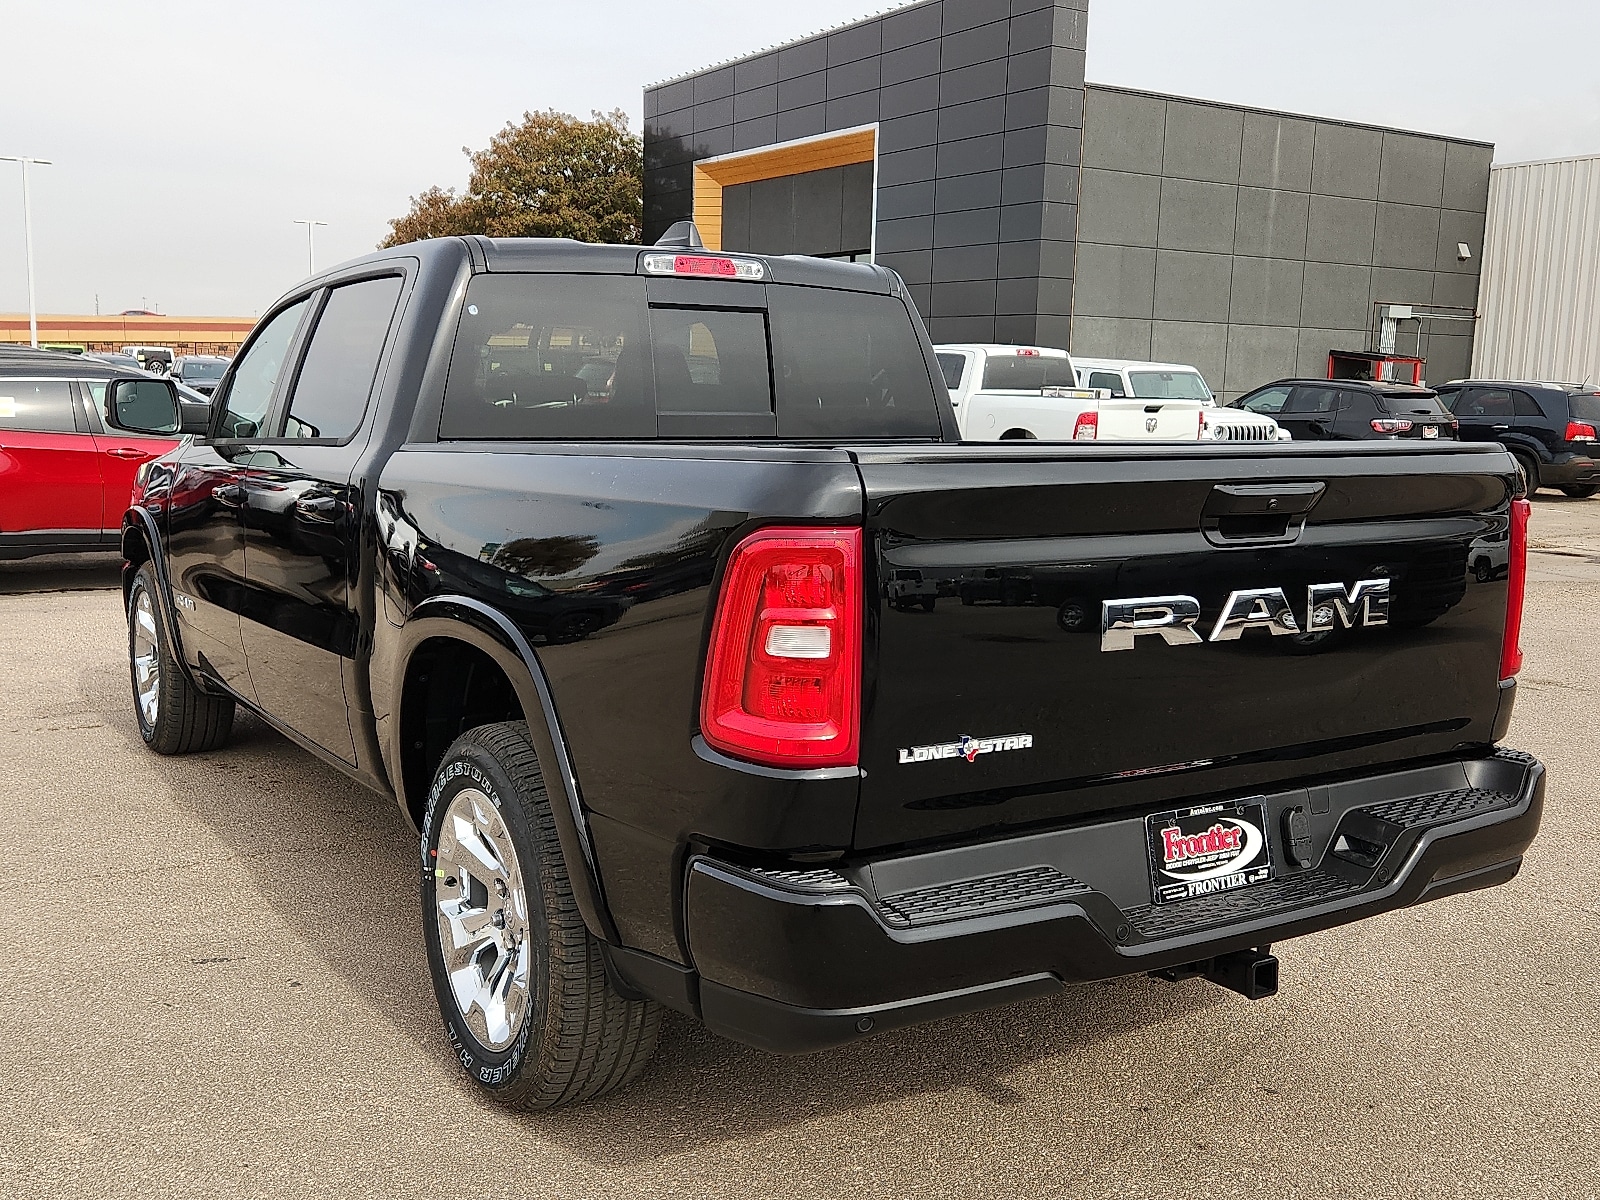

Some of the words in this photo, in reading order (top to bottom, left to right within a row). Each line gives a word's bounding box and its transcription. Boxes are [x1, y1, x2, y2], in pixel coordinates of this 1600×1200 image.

[1101, 579, 1390, 652] RAM
[898, 742, 962, 764] LONE
[978, 734, 1033, 754] STAR
[1161, 824, 1242, 862] Frontier
[1187, 872, 1248, 897] FRONTIER
